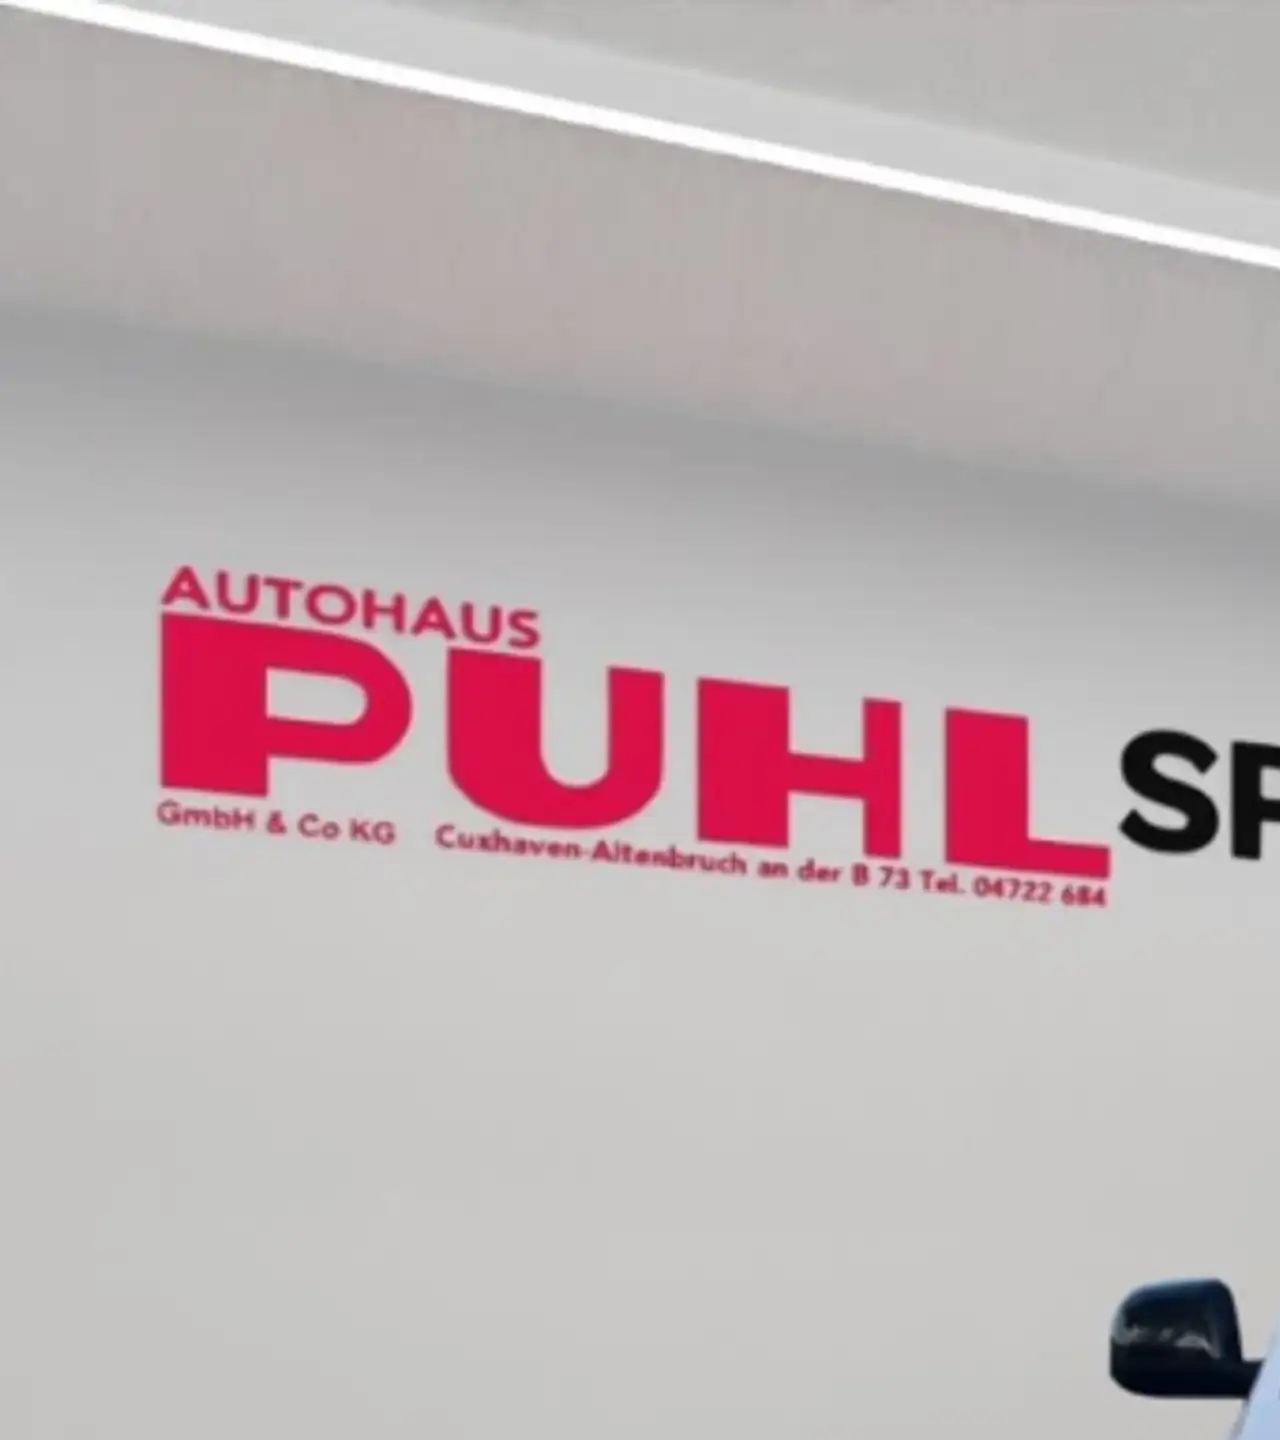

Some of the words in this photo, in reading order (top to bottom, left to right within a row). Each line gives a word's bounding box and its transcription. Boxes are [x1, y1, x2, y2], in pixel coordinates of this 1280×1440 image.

[162, 566, 542, 649] AUTOHAUS
[160, 610, 1111, 880] PUHL
[156, 799, 256, 831] GmbH
[266, 810, 287, 835] &
[297, 812, 341, 840] Co
[349, 817, 397, 845] KG
[434, 823, 748, 876] Cuxhaven-Altenbruch
[757, 858, 789, 880] an
[797, 858, 840, 884] der
[852, 862, 868, 886] B
[879, 866, 910, 891] 73
[917, 869, 965, 895] Tel.
[973, 875, 1055, 905] 04722
[1061, 883, 1107, 909] 684
